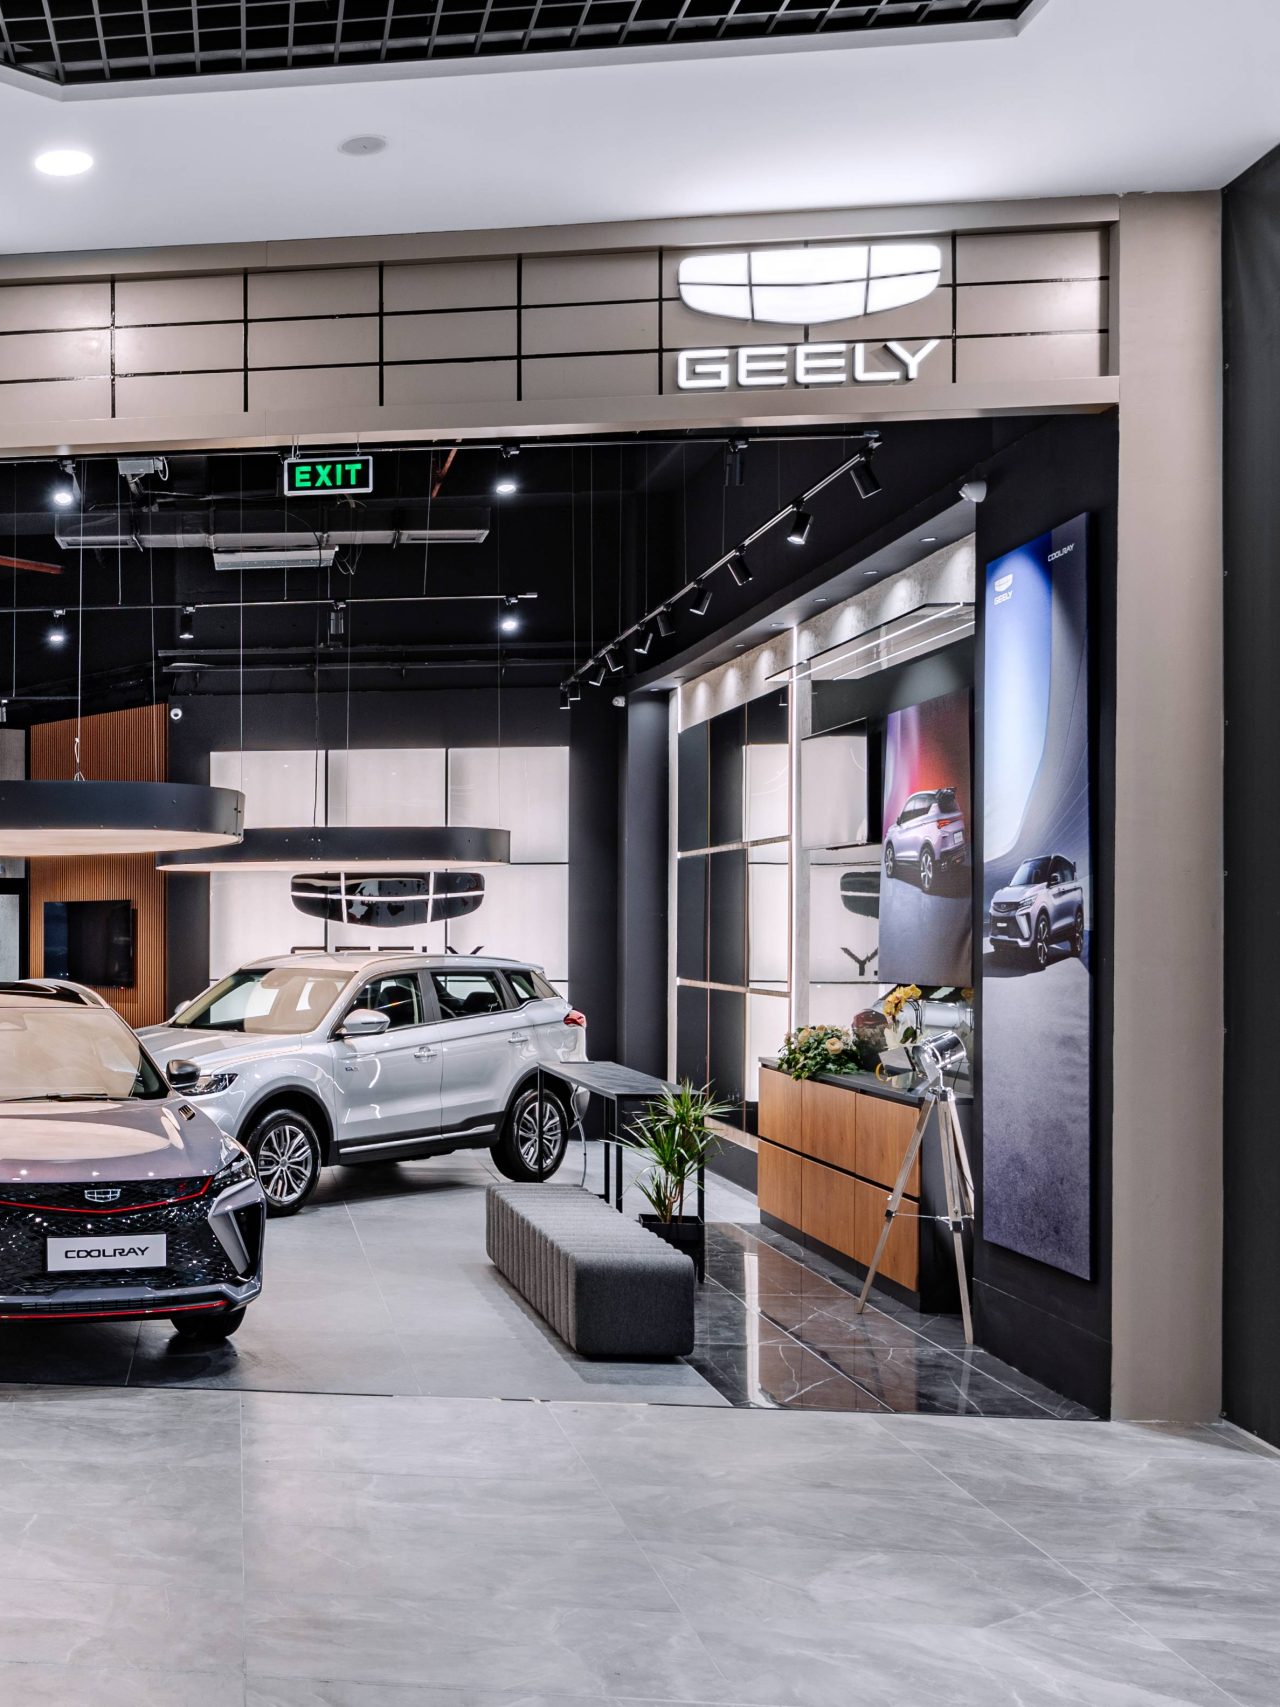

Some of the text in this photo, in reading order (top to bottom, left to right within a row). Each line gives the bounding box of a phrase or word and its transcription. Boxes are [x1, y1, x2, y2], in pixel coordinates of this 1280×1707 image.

[677, 339, 941, 389] GEELY
[295, 463, 362, 488] EXIT
[1047, 543, 1076, 562] COOLRAY
[993, 590, 1013, 606] GEELY
[64, 1246, 150, 1259] COOLRAY
